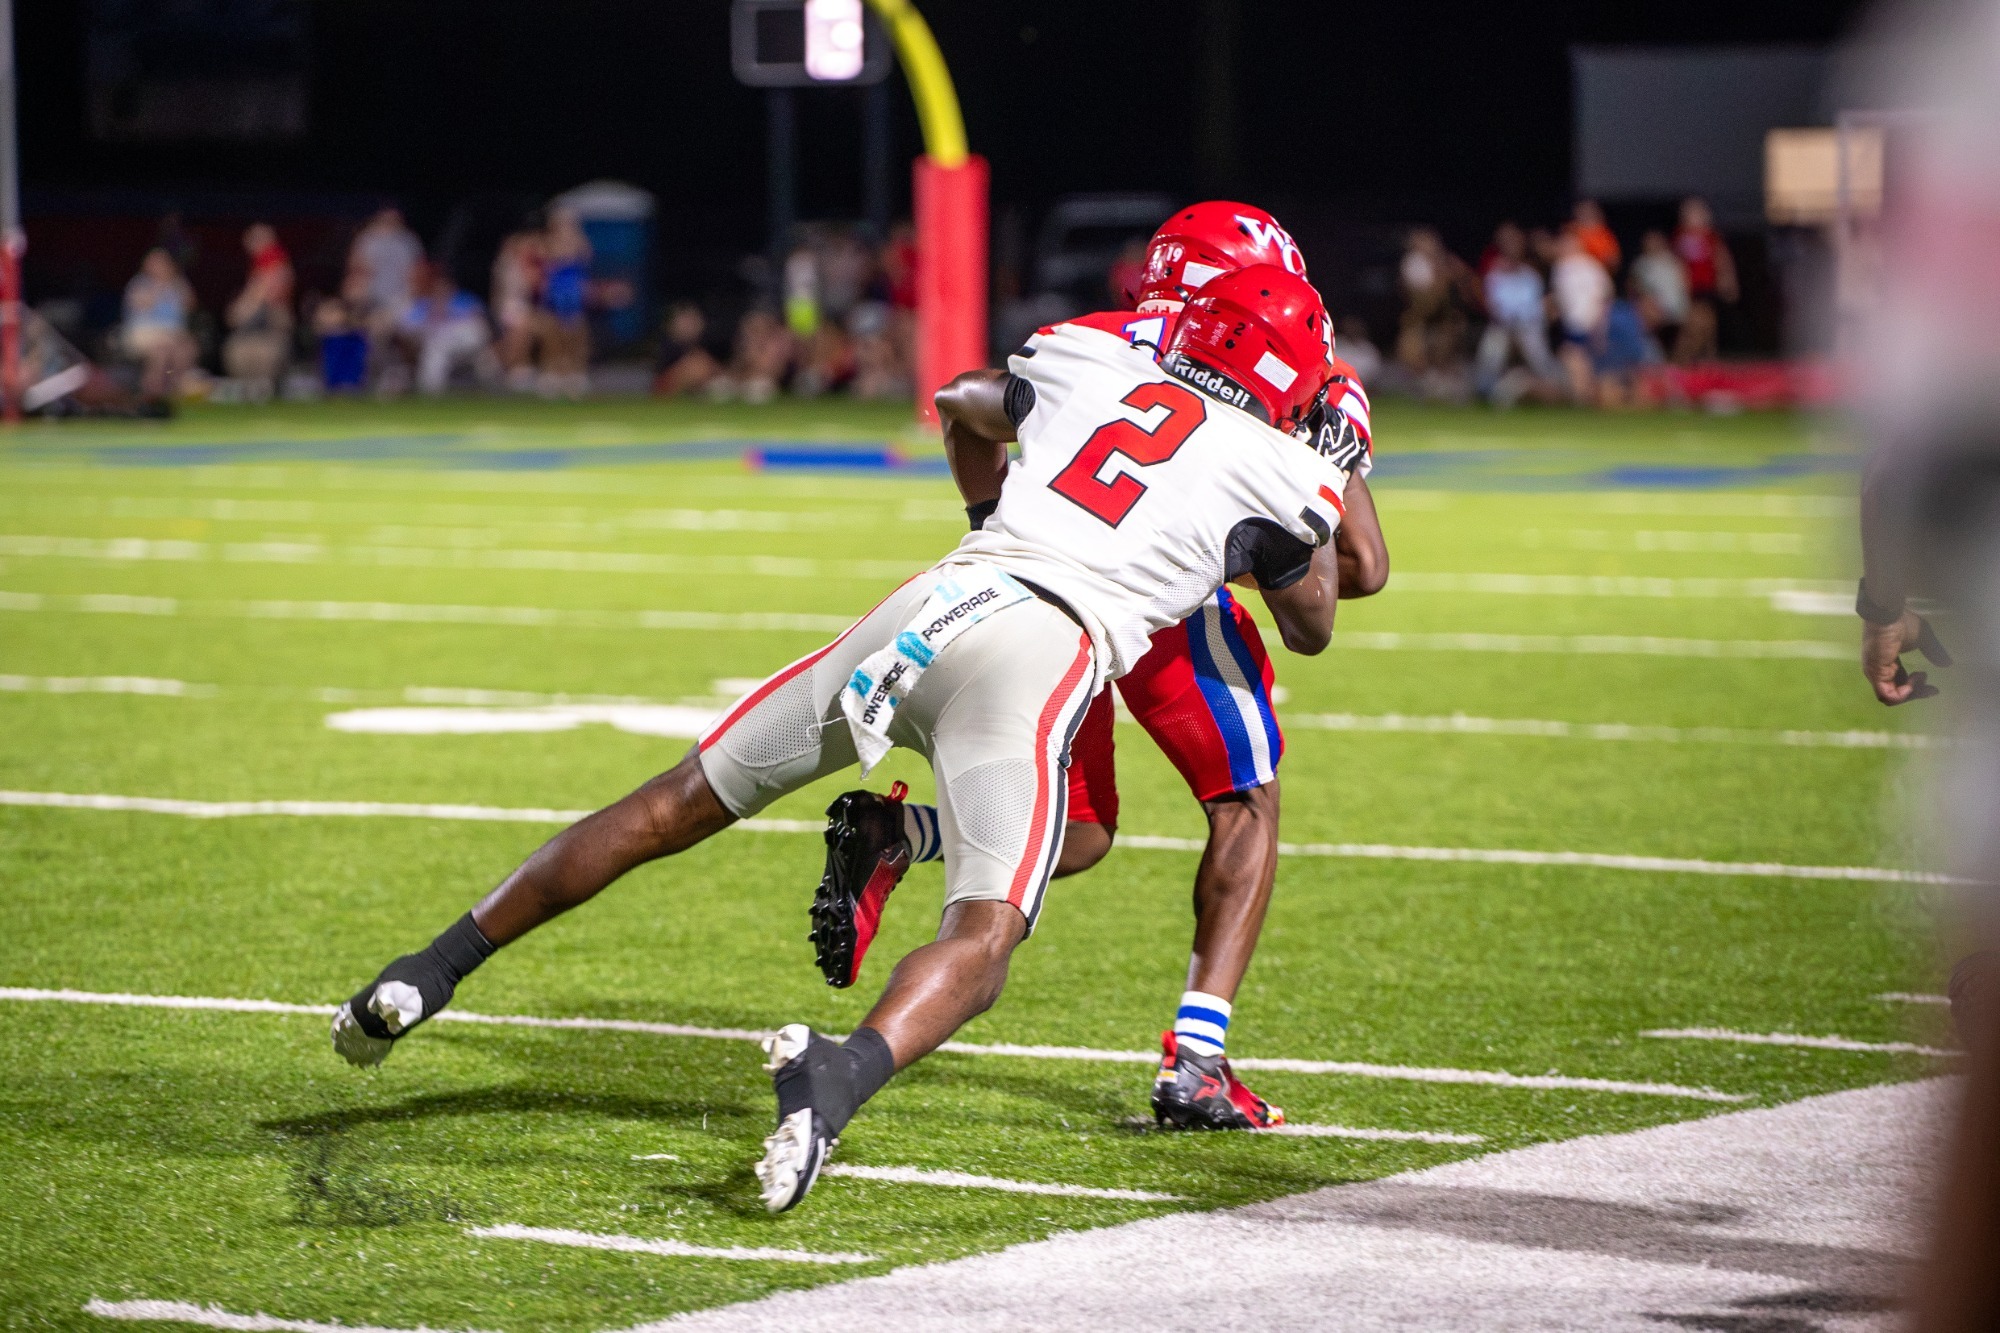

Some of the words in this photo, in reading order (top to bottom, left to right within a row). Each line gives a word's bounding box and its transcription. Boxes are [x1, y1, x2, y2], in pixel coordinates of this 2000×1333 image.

[1166, 246, 1184, 263] 19
[1233, 322, 1247, 337] 2
[1174, 357, 1251, 409] Riddell
[1047, 380, 1208, 530] 2
[922, 587, 1001, 641] POWERADE
[862, 661, 909, 726] OWERADE
